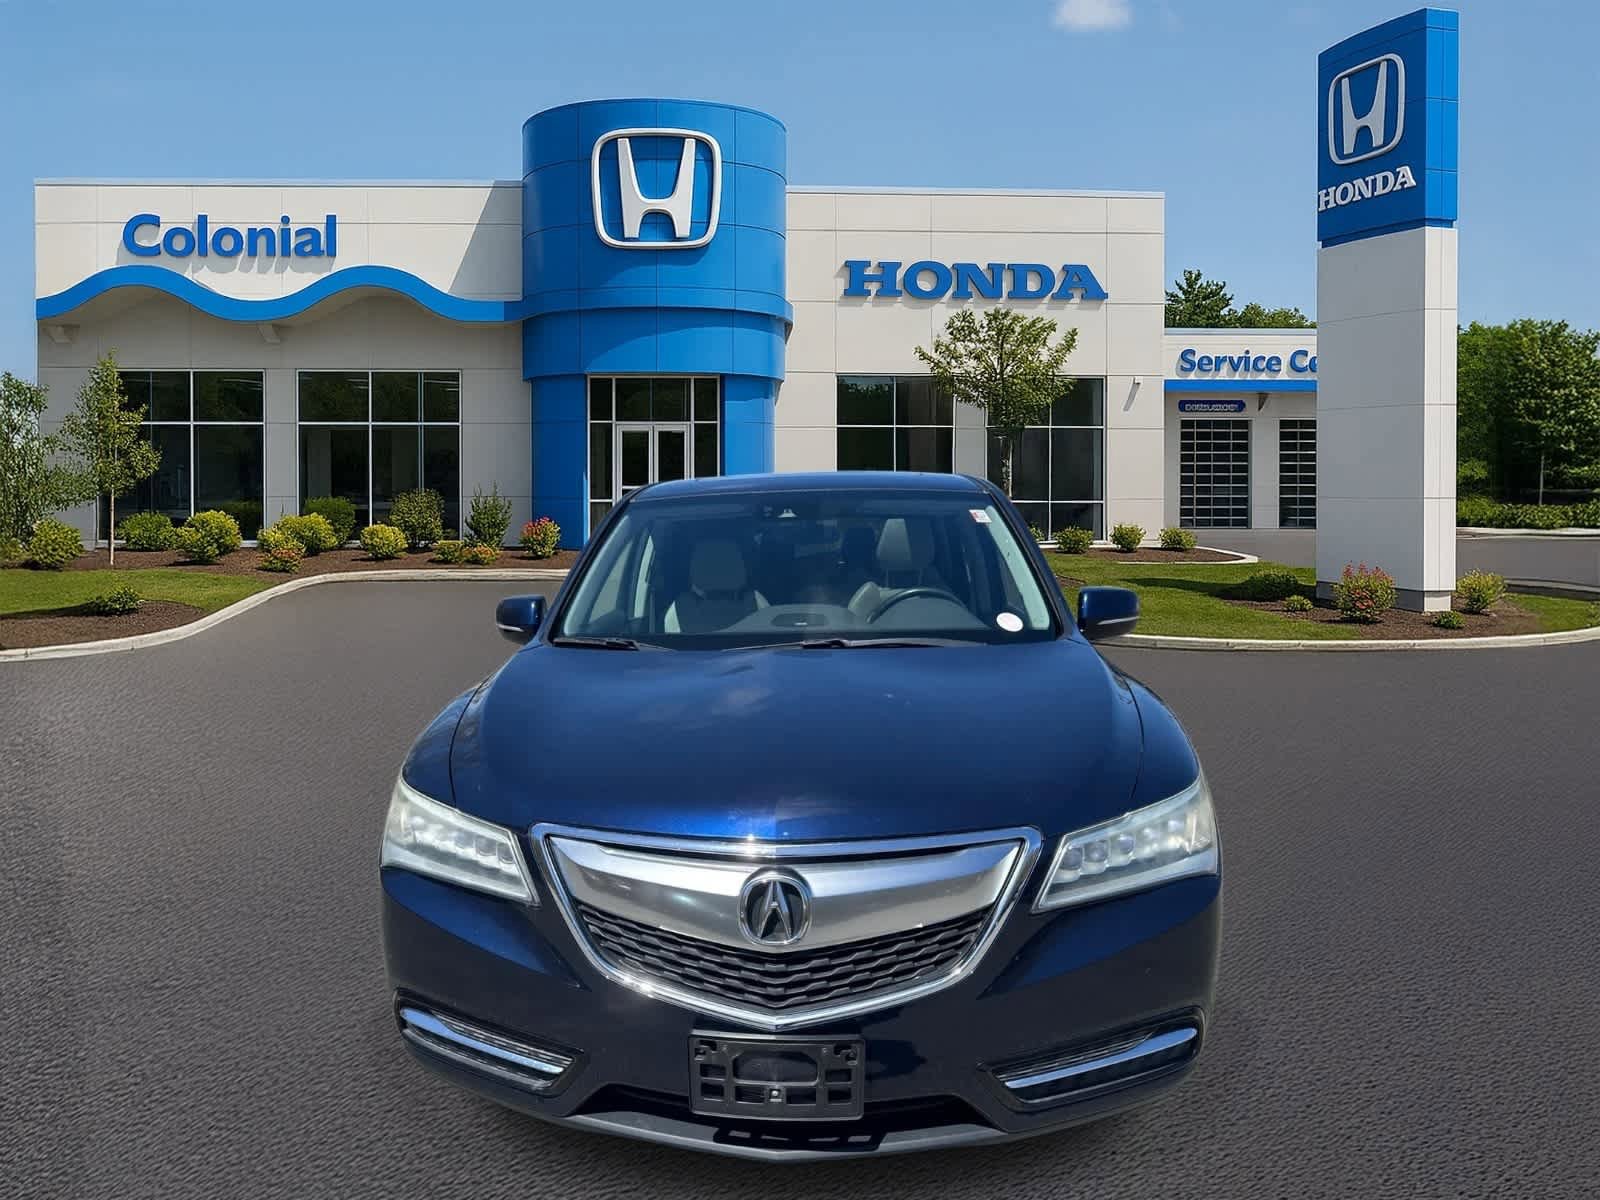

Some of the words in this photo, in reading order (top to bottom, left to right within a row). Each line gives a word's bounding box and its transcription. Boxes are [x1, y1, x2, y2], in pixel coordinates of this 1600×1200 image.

[1318, 165, 1416, 212] HONDA
[122, 213, 337, 257] Colonial
[843, 260, 1109, 300] HONDA
[1180, 349, 1281, 373] Service
